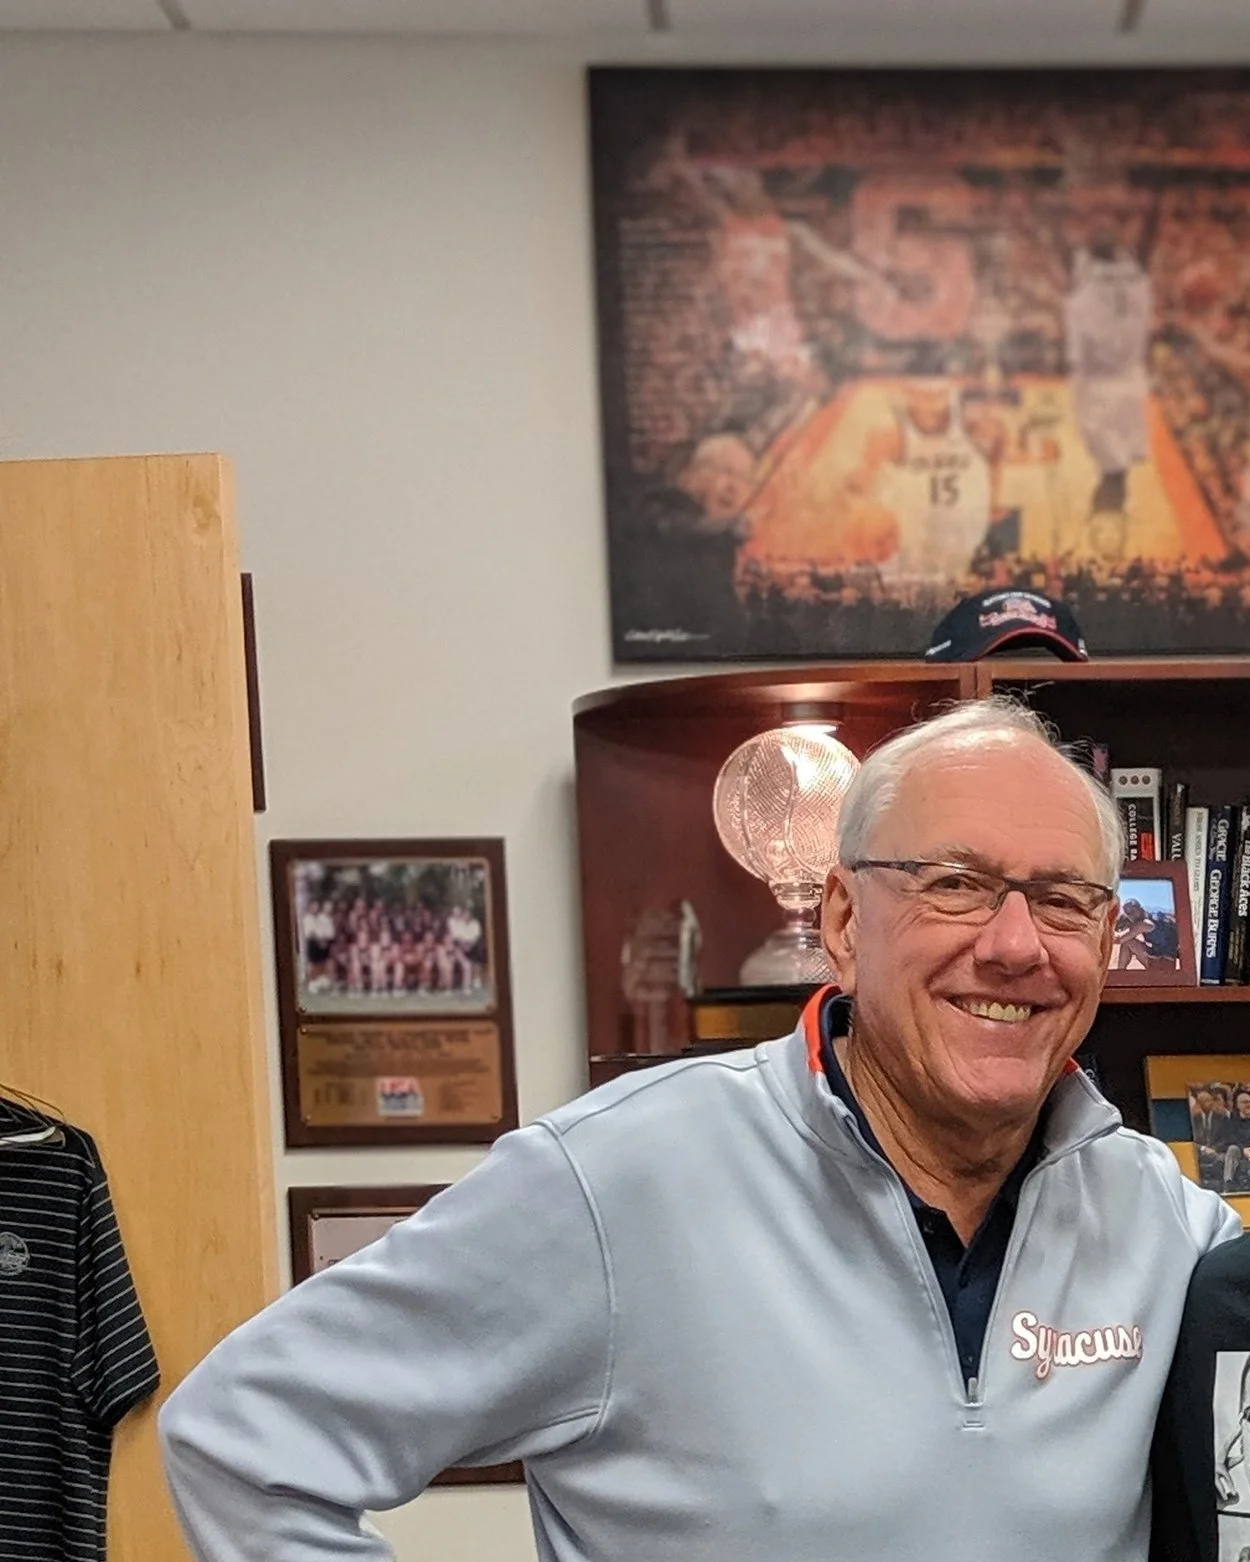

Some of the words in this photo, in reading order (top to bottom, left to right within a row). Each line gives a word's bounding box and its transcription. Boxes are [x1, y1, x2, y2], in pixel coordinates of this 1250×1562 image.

[930, 474, 960, 508] 15
[1127, 803, 1138, 846] COLLEGE
[1216, 819, 1230, 862] GRACIE
[1208, 869, 1222, 918] GEORGE
[1206, 919, 1220, 958] BURNS
[1010, 1310, 1144, 1381] Syacuse
